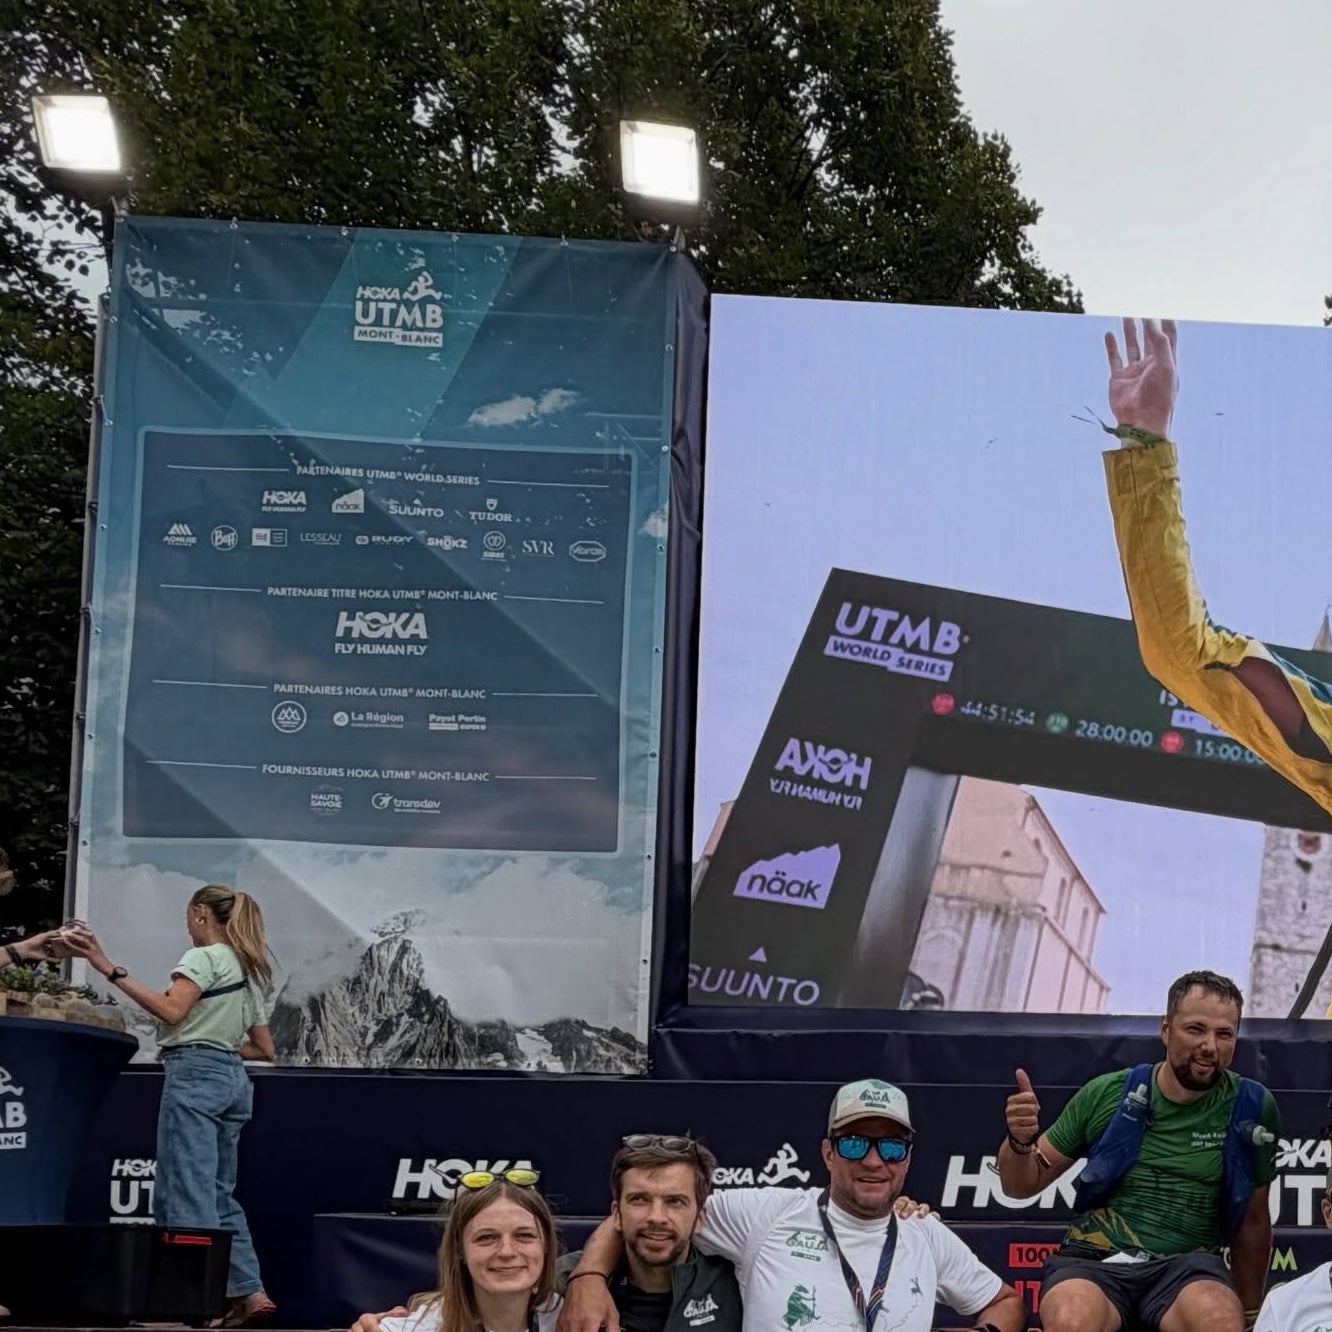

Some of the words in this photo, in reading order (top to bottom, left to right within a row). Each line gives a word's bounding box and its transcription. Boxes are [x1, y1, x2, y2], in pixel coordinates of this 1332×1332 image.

[356, 286, 400, 300] HOKA
[355, 300, 444, 329] UTMB
[296, 466, 364, 477] PARTENAIRES
[404, 472, 444, 483] WORLD
[447, 476, 481, 486] SERIES
[262, 490, 307, 505] HOKA
[388, 504, 444, 518] SUUNTO
[469, 511, 513, 522] TUDOR
[522, 540, 554, 555] SVR
[267, 587, 329, 598] PARTENAIRE
[331, 588, 357, 598] TITRE
[359, 589, 390, 599] HOKA
[427, 591, 498, 601] MONT-BLANC
[335, 611, 428, 640] HOKA
[835, 602, 960, 655] UTMB
[334, 643, 357, 654] FLY
[357, 644, 405, 655] HUMAN
[407, 644, 427, 656] FLY
[833, 640, 891, 661] WORLD
[896, 656, 946, 676] SERIES
[273, 684, 343, 696] PARTENAIRES
[345, 686, 377, 696] HOKA
[416, 689, 486, 699] MONT-BLANC
[351, 712, 364, 721] La
[366, 712, 404, 723] Région
[262, 764, 344, 777] FOURNISSEURS
[347, 769, 379, 779] HOKA
[418, 771, 490, 782] MONT-BLANC
[393, 797, 441, 809] transdev
[1275, 1138, 1331, 1168] OKA
[111, 1159, 157, 1177] HOK
[712, 1167, 754, 1185] OKA
[110, 1180, 155, 1214] UT
